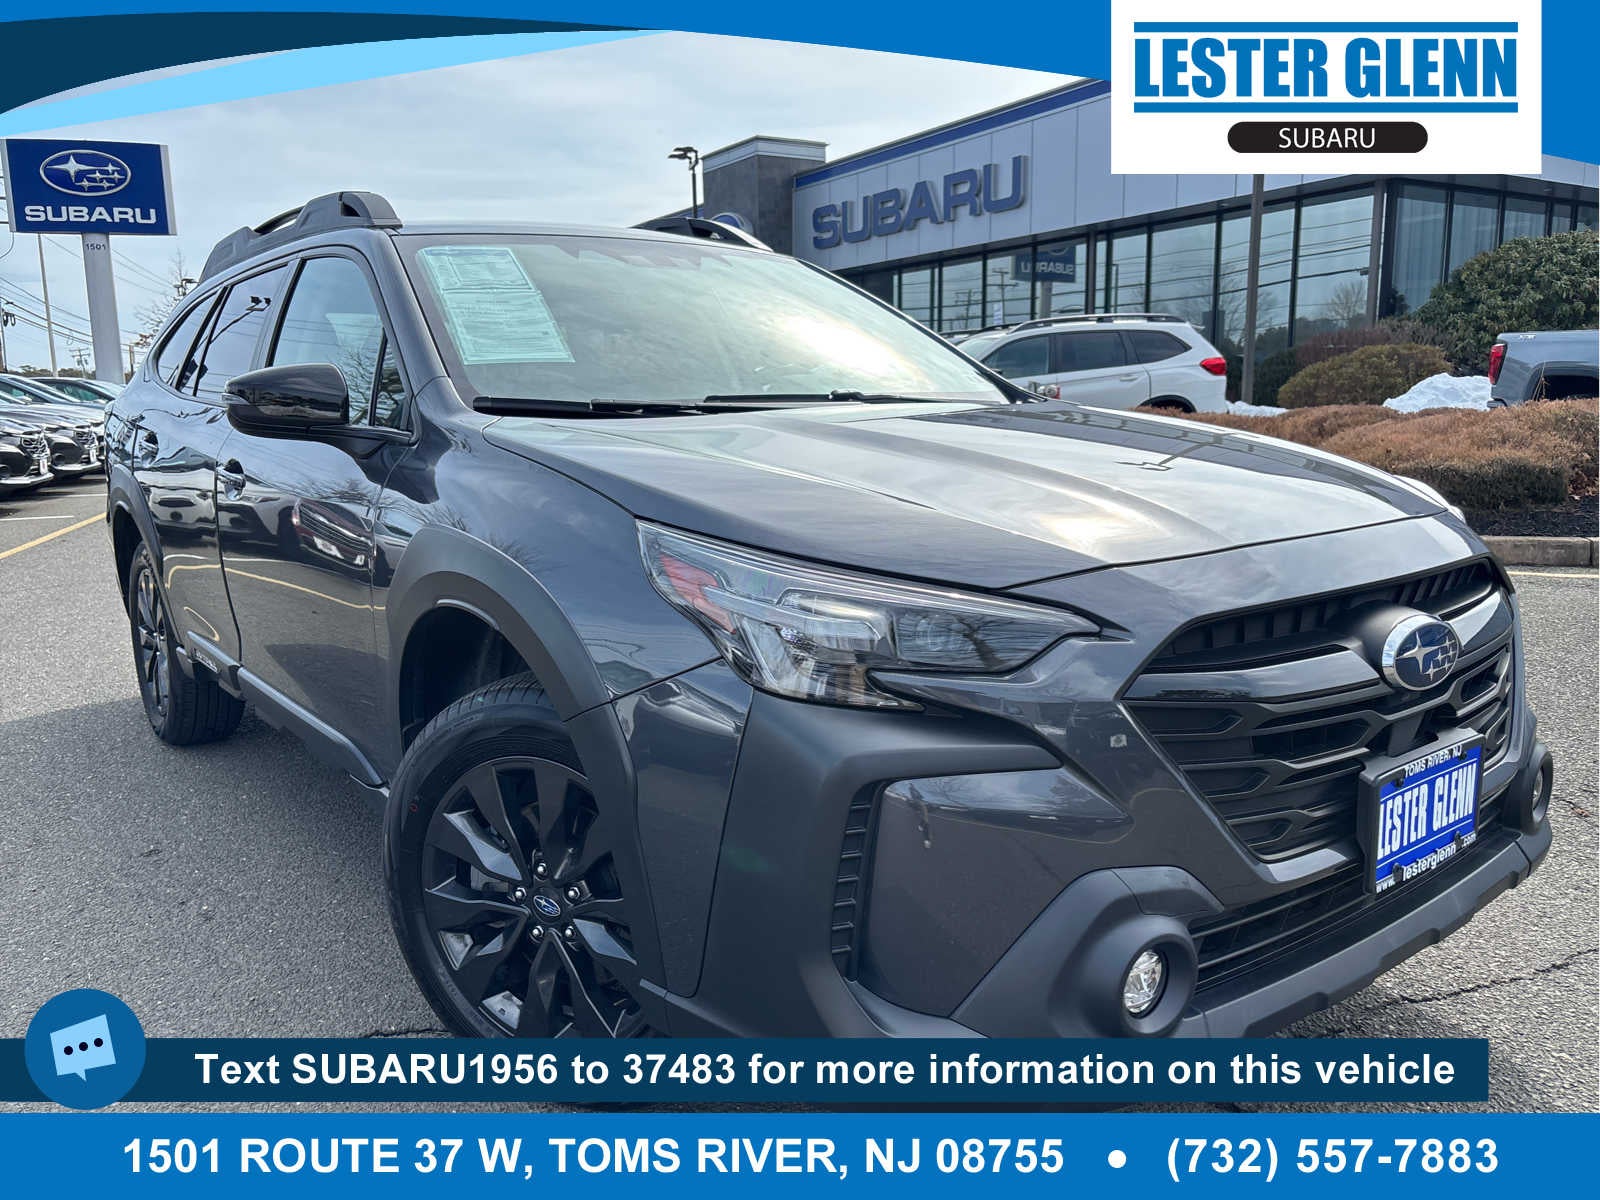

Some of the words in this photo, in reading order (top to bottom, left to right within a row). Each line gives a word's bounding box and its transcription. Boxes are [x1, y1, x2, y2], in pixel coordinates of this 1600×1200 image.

[24, 205, 157, 224] SUBARU
[812, 154, 1028, 249] SUBARU
[86, 243, 106, 251] 1501
[1404, 759, 1426, 778] TOMS
[1452, 745, 1463, 758] NJ
[1377, 783, 1428, 860] LESTER
[1432, 763, 1477, 831] GLENN
